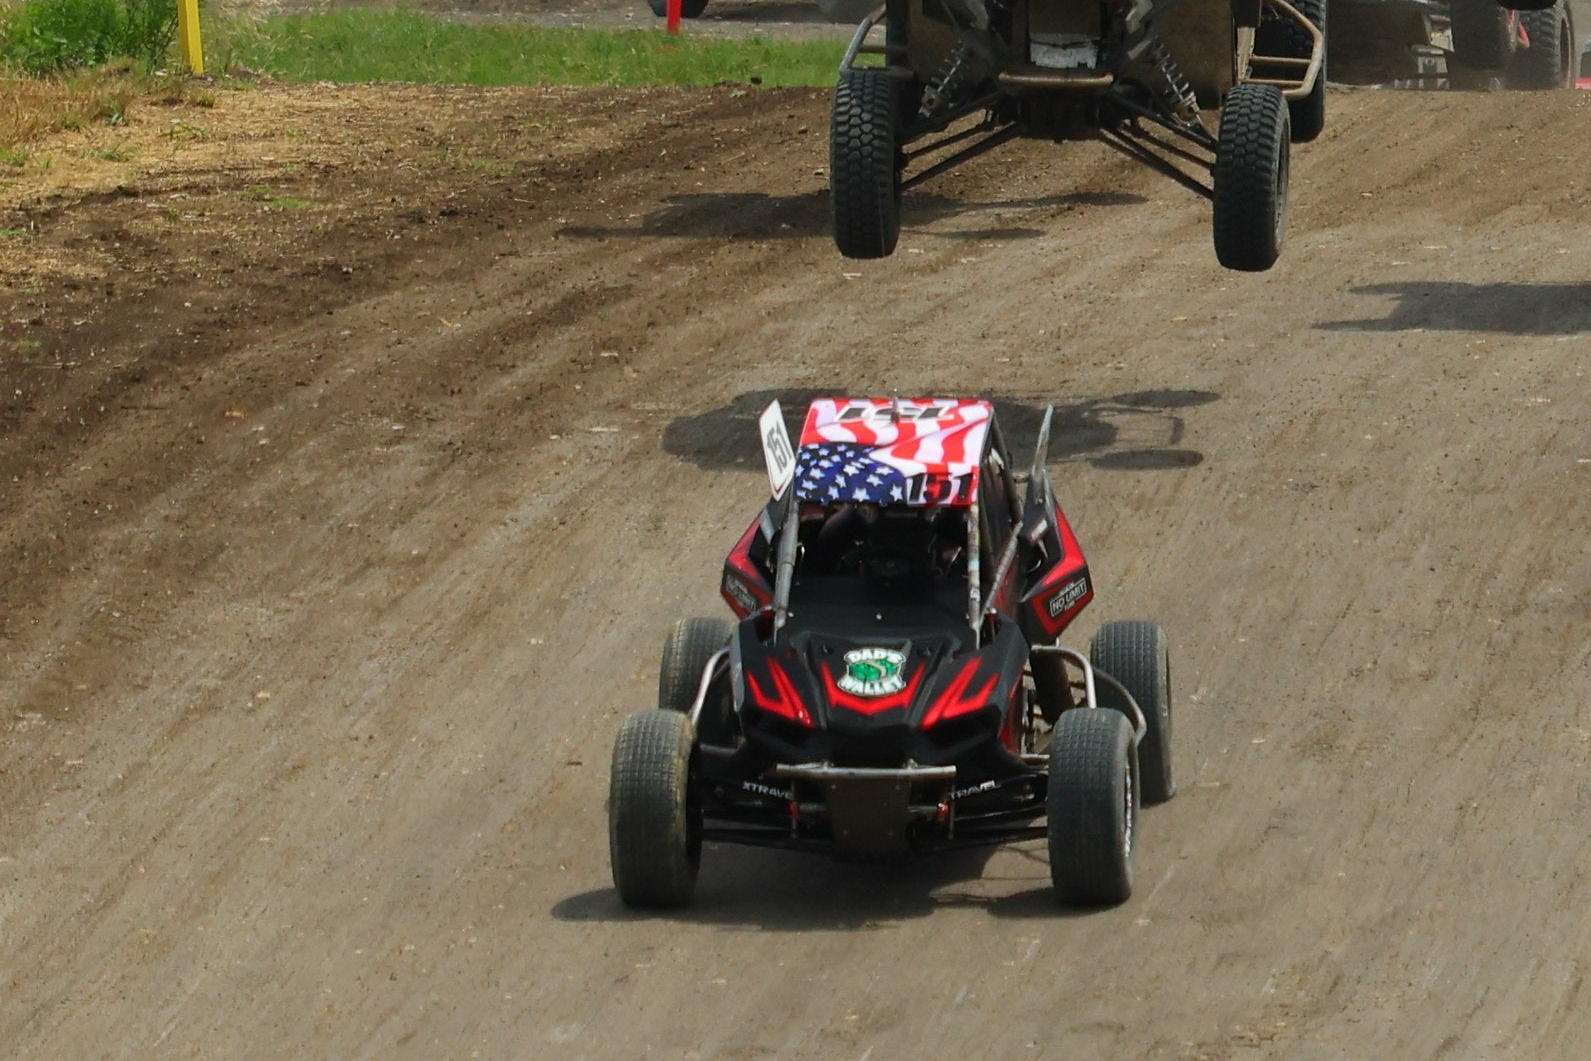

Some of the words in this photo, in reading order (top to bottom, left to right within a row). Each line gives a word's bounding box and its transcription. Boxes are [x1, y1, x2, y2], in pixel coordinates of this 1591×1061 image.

[767, 420, 793, 473] 151
[907, 471, 975, 504] 151
[1052, 596, 1065, 612] NO
[844, 648, 906, 665] DAD'S
[837, 676, 907, 696] WALLET
